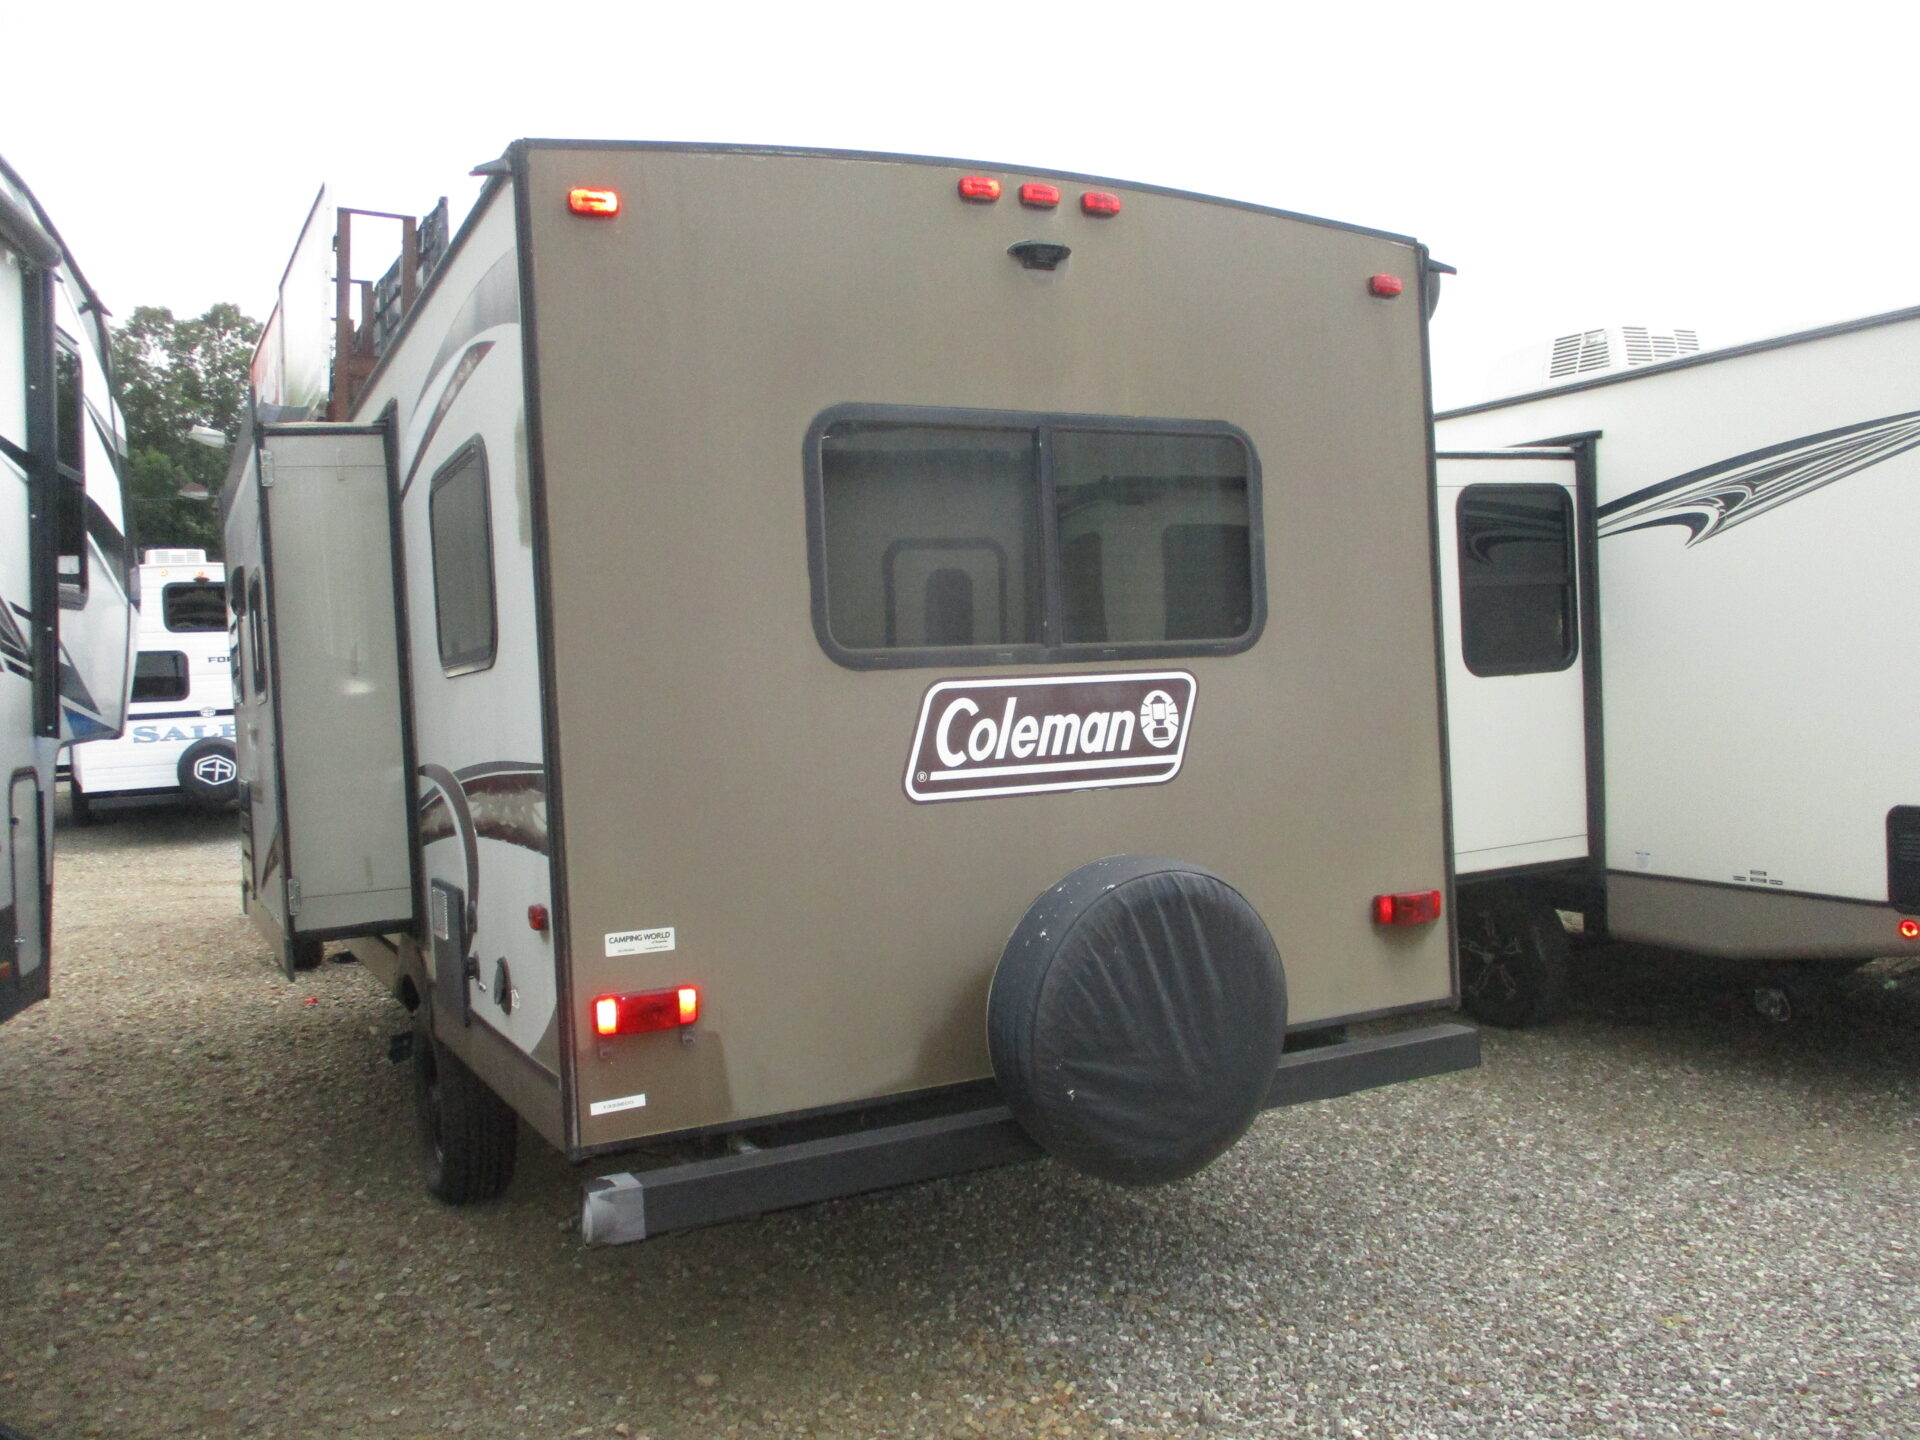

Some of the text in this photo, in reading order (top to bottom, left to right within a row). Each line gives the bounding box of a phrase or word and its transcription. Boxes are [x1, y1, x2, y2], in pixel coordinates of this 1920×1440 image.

[936, 696, 1136, 768] Coleman
[608, 935, 643, 945] CAMPING
[643, 931, 671, 940] WORLD
